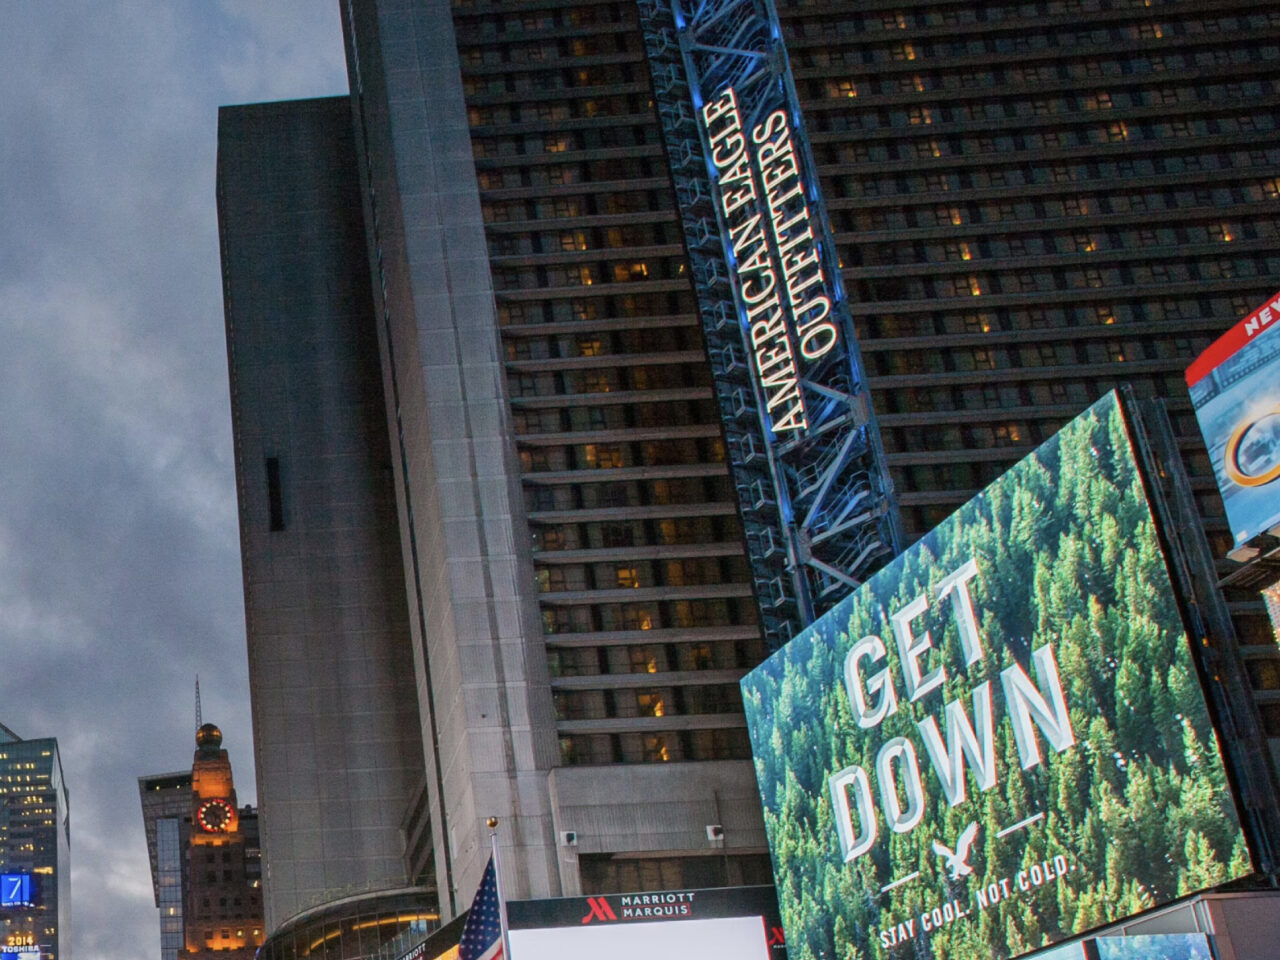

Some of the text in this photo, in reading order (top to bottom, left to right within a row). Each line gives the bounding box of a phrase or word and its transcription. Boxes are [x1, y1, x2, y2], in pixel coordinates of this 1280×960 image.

[703, 86, 807, 433] AMERICAN EAGLE
[753, 110, 838, 360] OUTFITTERS
[843, 557, 984, 729] GET
[828, 643, 1076, 863] DOWN
[8, 877, 22, 899] 7
[621, 892, 695, 906] MARRIOTT
[623, 905, 688, 917] MARQUIS
[880, 855, 1077, 950] STAY COOL. NOT COLD.
[2, 945, 39, 953] TOSHIBA
[8, 935, 34, 946] 2014
